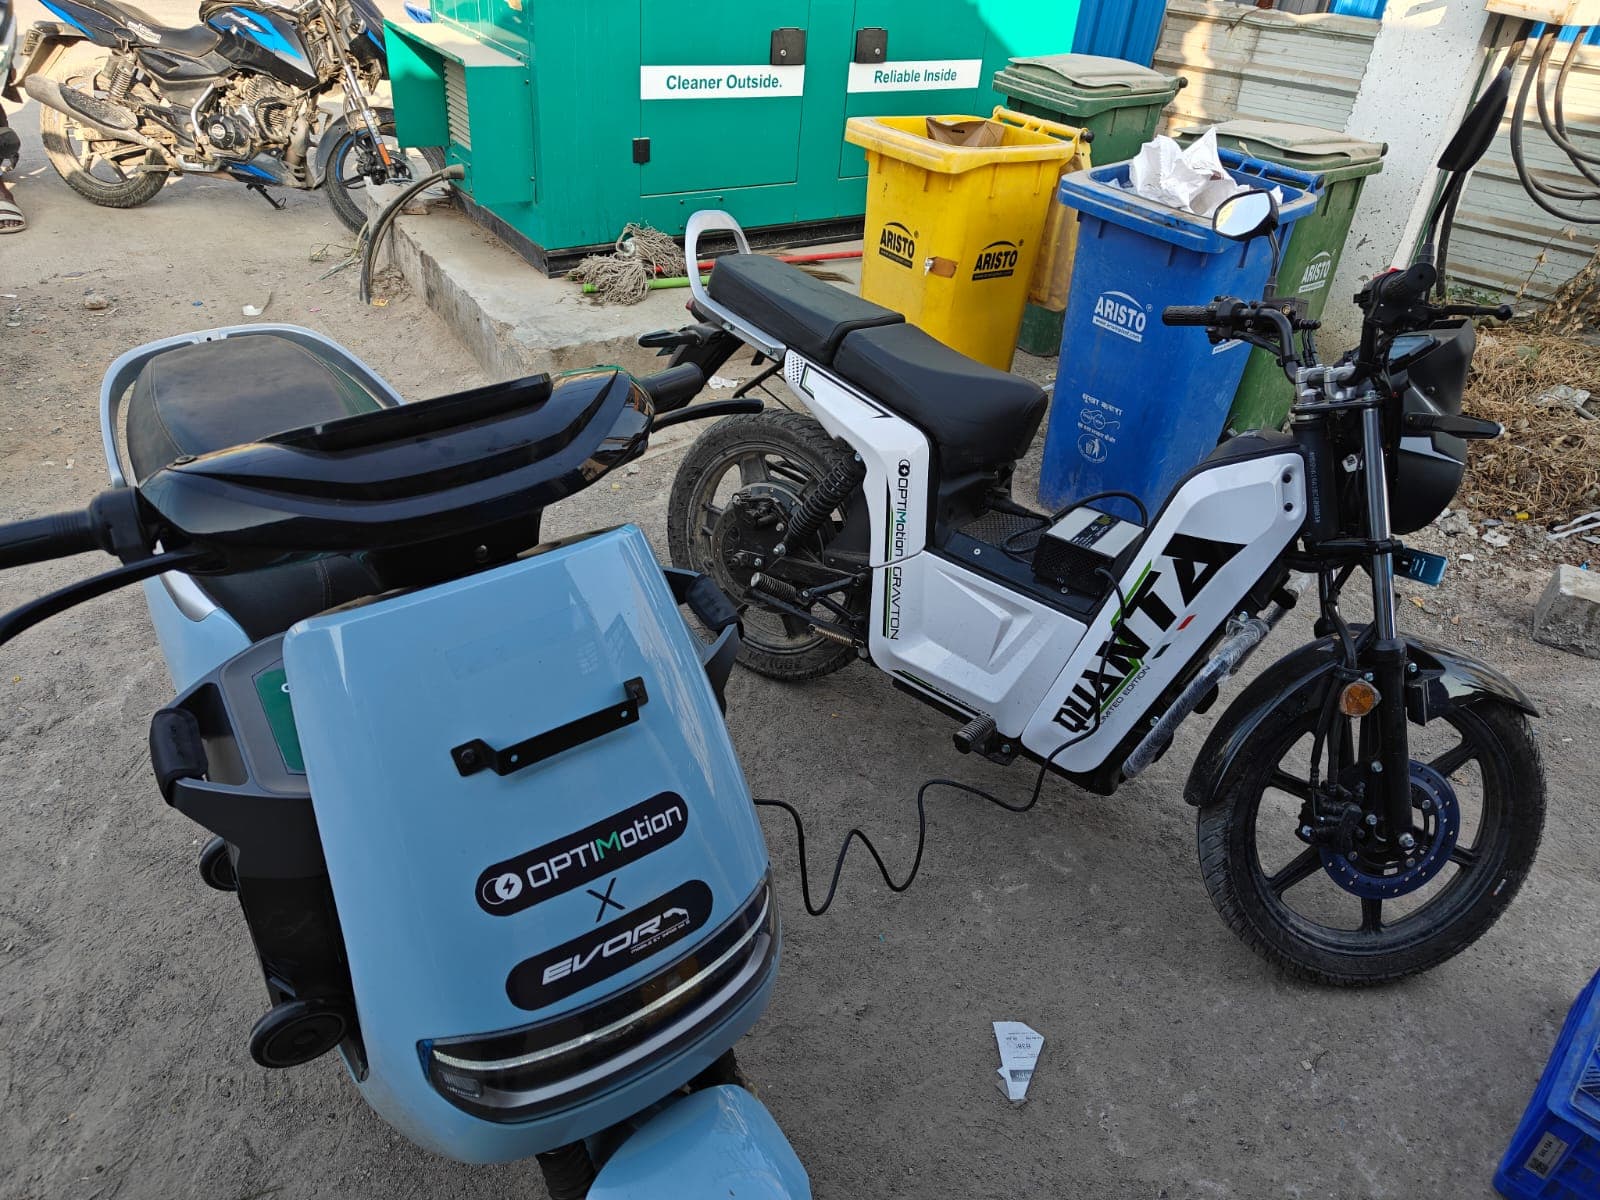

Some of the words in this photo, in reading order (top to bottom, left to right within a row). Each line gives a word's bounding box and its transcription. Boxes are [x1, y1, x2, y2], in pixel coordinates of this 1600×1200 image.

[666, 75, 723, 90] Cleaner
[726, 74, 783, 89] Outside.
[874, 69, 921, 84] Reliable
[923, 68, 957, 82] Inside
[880, 228, 915, 259] ARISTO
[973, 250, 1018, 272] ARISTO
[1301, 260, 1331, 284] ARISTO
[1094, 296, 1146, 333] ARISTO
[896, 478, 911, 557] OPTIMotion
[890, 566, 903, 640] GRAVTON
[1052, 533, 1248, 733] QUANTA
[1122, 665, 1150, 697] EDITION
[526, 806, 683, 888] OPTIMotion
